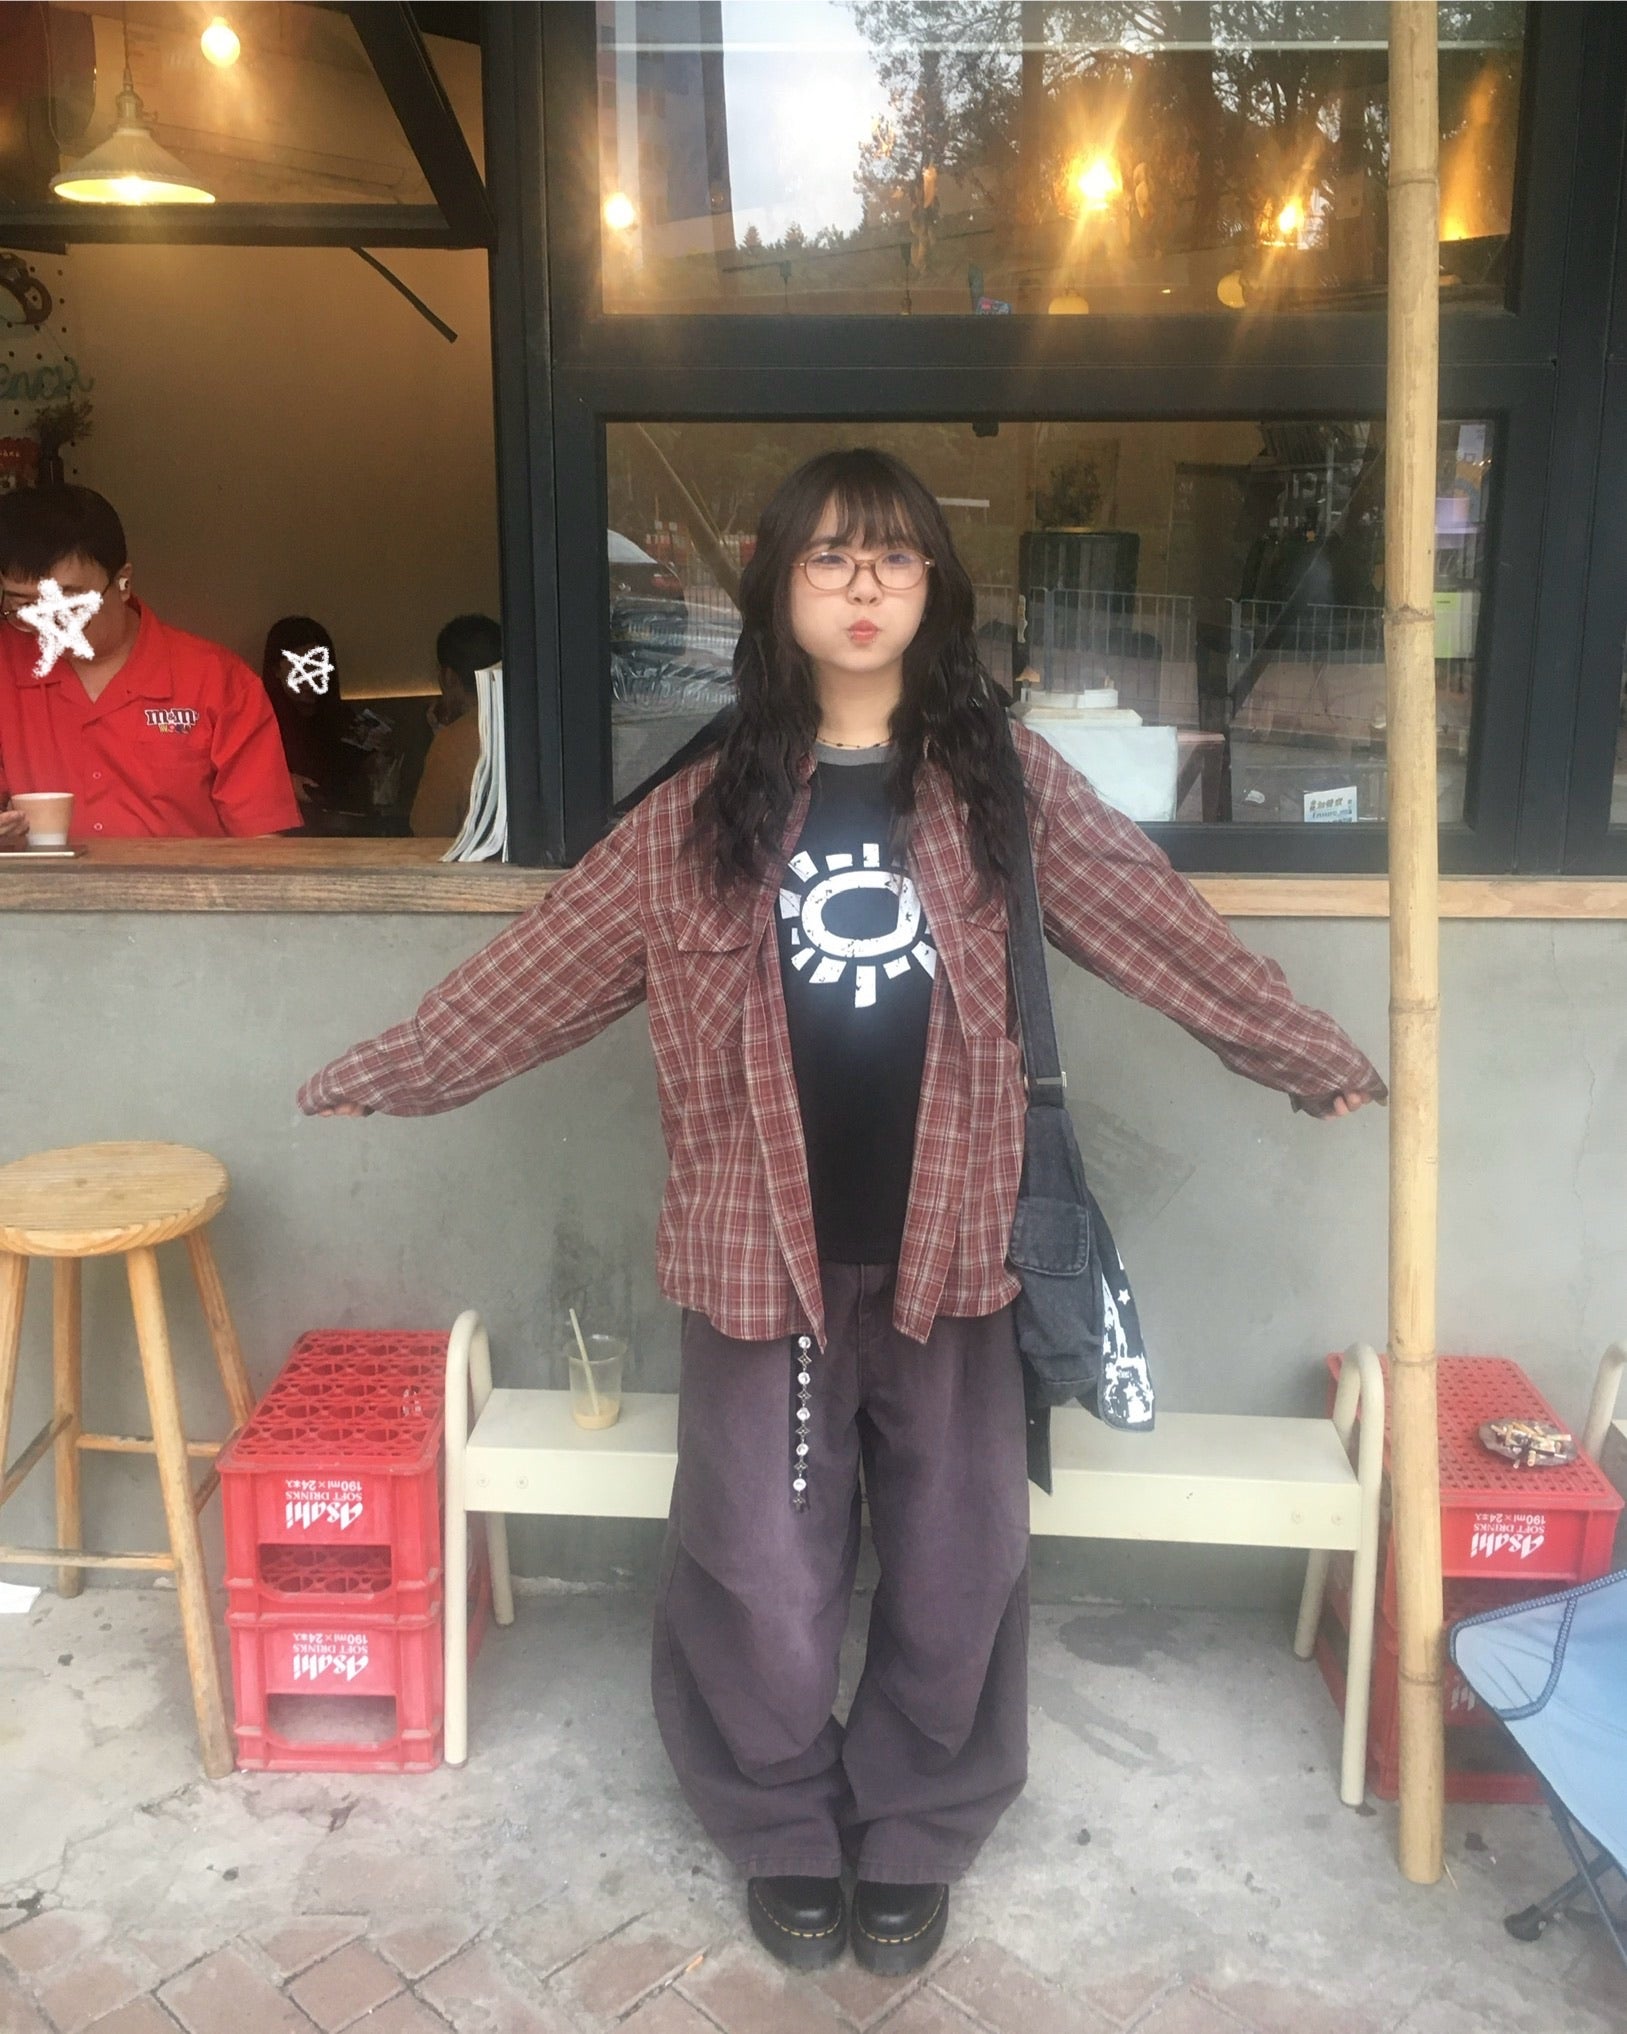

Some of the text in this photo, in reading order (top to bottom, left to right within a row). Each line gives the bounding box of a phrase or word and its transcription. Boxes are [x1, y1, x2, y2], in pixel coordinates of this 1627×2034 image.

[285, 1490, 362, 1501] SOFT DRINKS
[286, 1501, 363, 1531] Asahi
[1473, 1523, 1545, 1534] SOFT DRINKS
[1470, 1532, 1545, 1559] Asahi
[292, 1643, 368, 1655] SOFT DRINKS
[293, 1653, 369, 1682] Asahi
